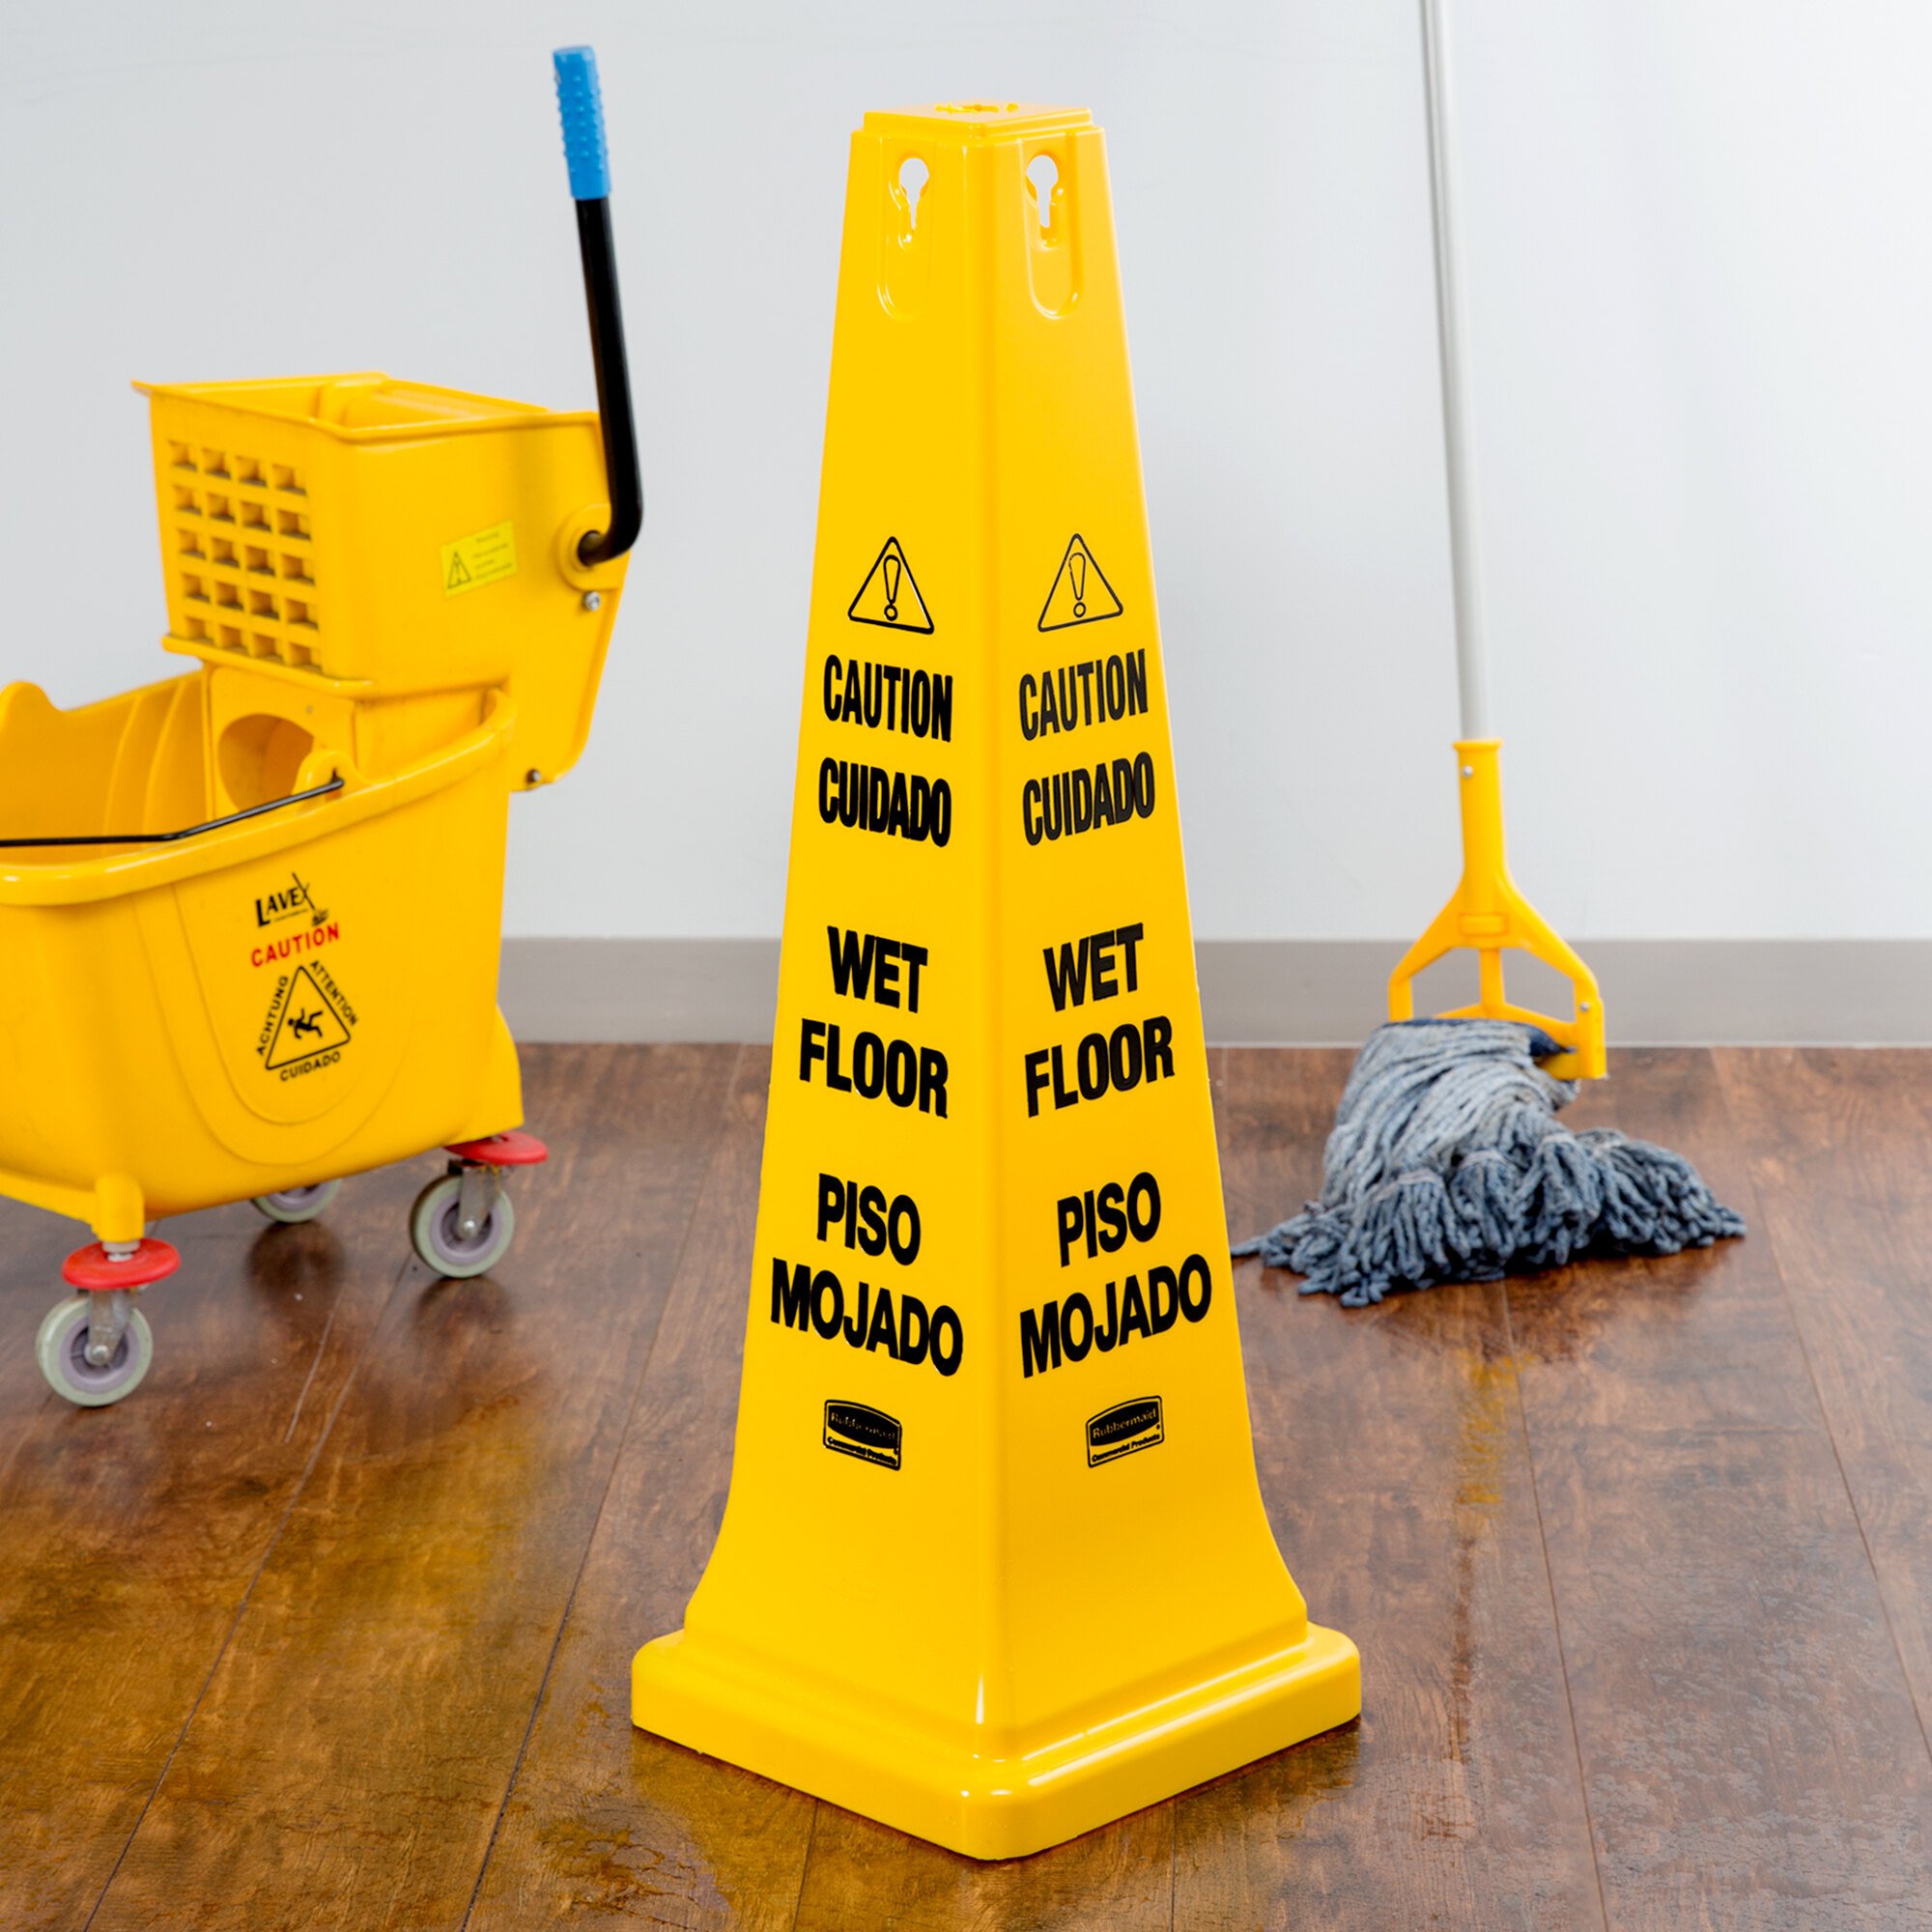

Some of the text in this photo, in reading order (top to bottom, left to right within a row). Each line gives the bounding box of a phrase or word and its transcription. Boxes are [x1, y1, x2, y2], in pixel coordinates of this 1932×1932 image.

[824, 654, 953, 743] CAUTION
[1019, 648, 1149, 741] CAUTION
[818, 756, 952, 848] CUIDADO
[1022, 752, 1155, 846] CUIDADO
[250, 922, 341, 968] CAUTION
[255, 882, 310, 927] LAVEX
[310, 960, 358, 1027] ATTENTION
[827, 925, 928, 1013] WET
[1042, 922, 1144, 1012] WET
[256, 975, 290, 1057] ACHTUNG
[279, 1050, 342, 1082] CUIDADO
[799, 1018, 949, 1120] FLOOR
[1024, 1015, 1176, 1118] FLOOR
[816, 1173, 922, 1266] PISO
[1057, 1172, 1161, 1268] PISO
[770, 1257, 964, 1377] MOJADO
[1019, 1253, 1212, 1378] MOJADO
[1093, 1407, 1156, 1439] Rubbermaid
